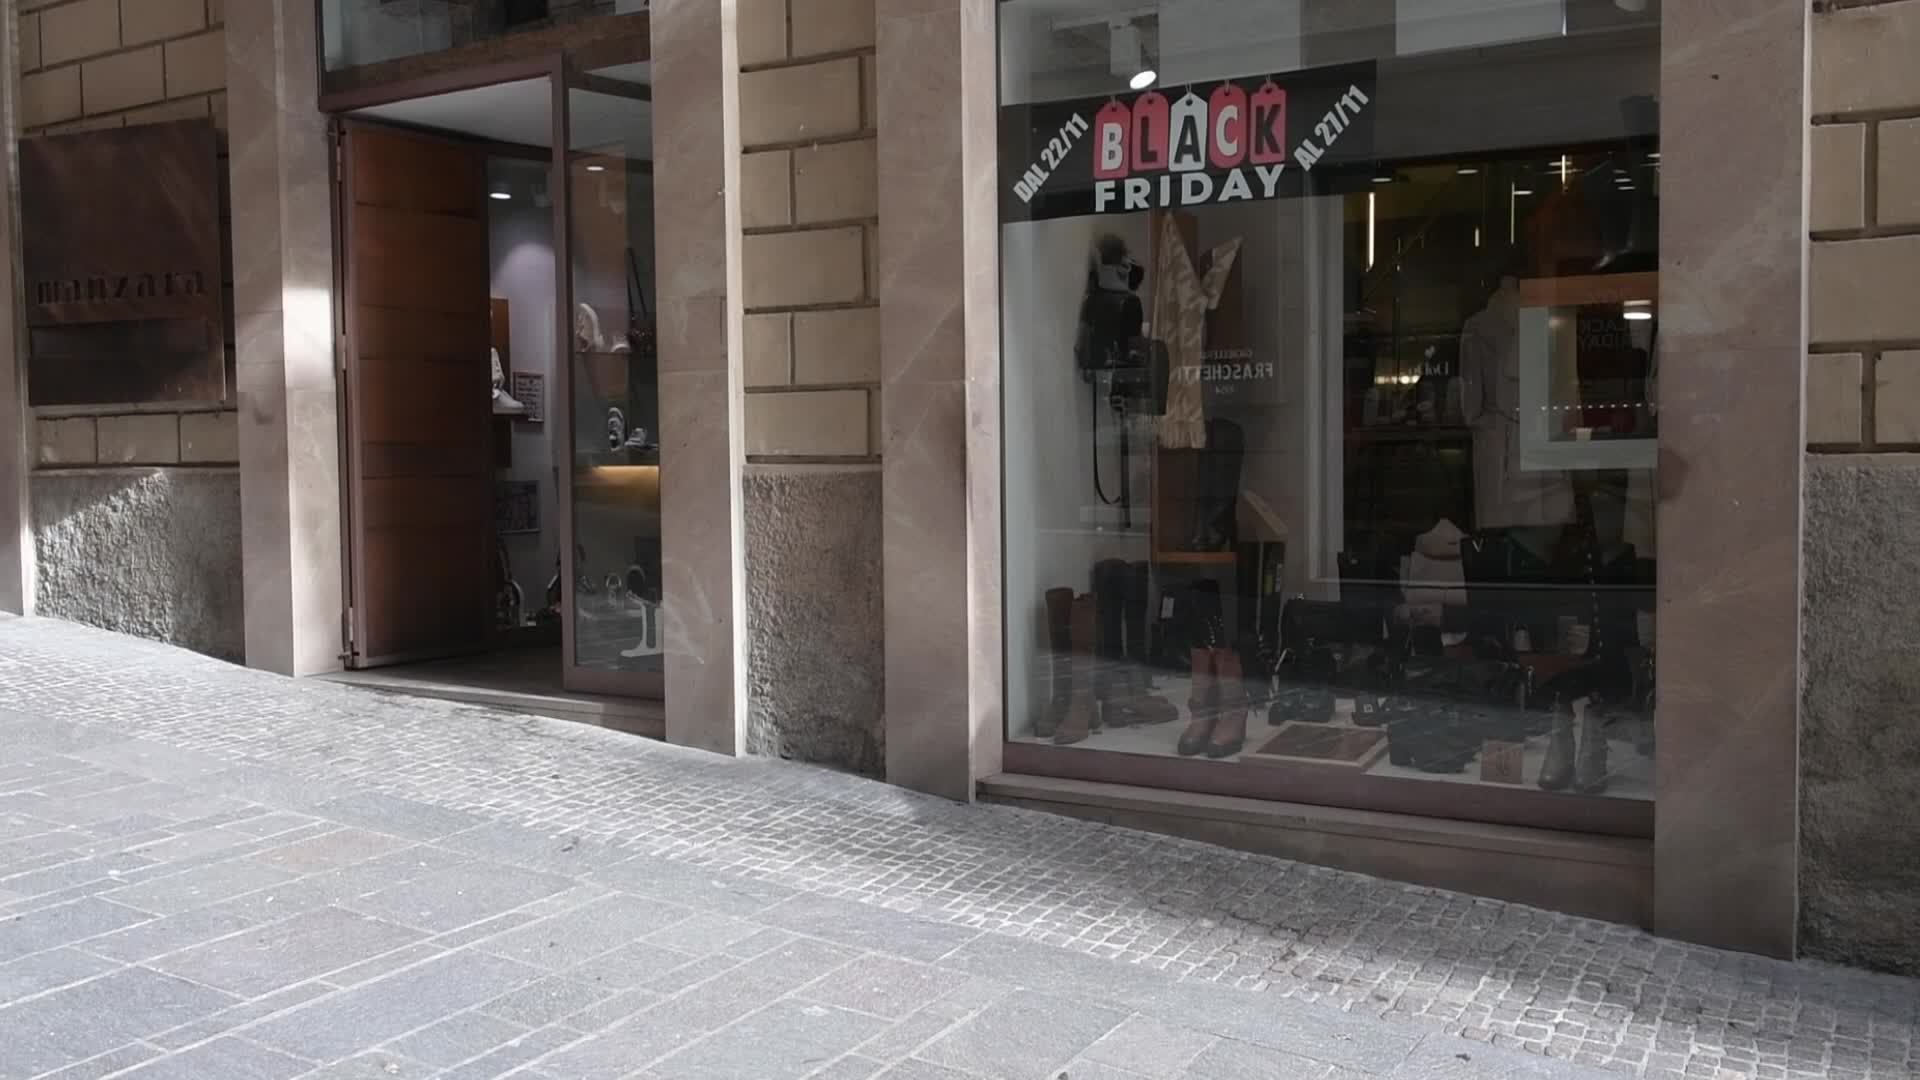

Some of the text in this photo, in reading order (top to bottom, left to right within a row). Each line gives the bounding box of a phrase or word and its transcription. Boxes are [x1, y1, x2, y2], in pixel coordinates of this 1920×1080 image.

[1013, 112, 1089, 203] DAL 22/11
[1100, 103, 1282, 171] BLACK
[1294, 84, 1369, 172] AL 27/11
[1095, 163, 1285, 213] FRIDAY
